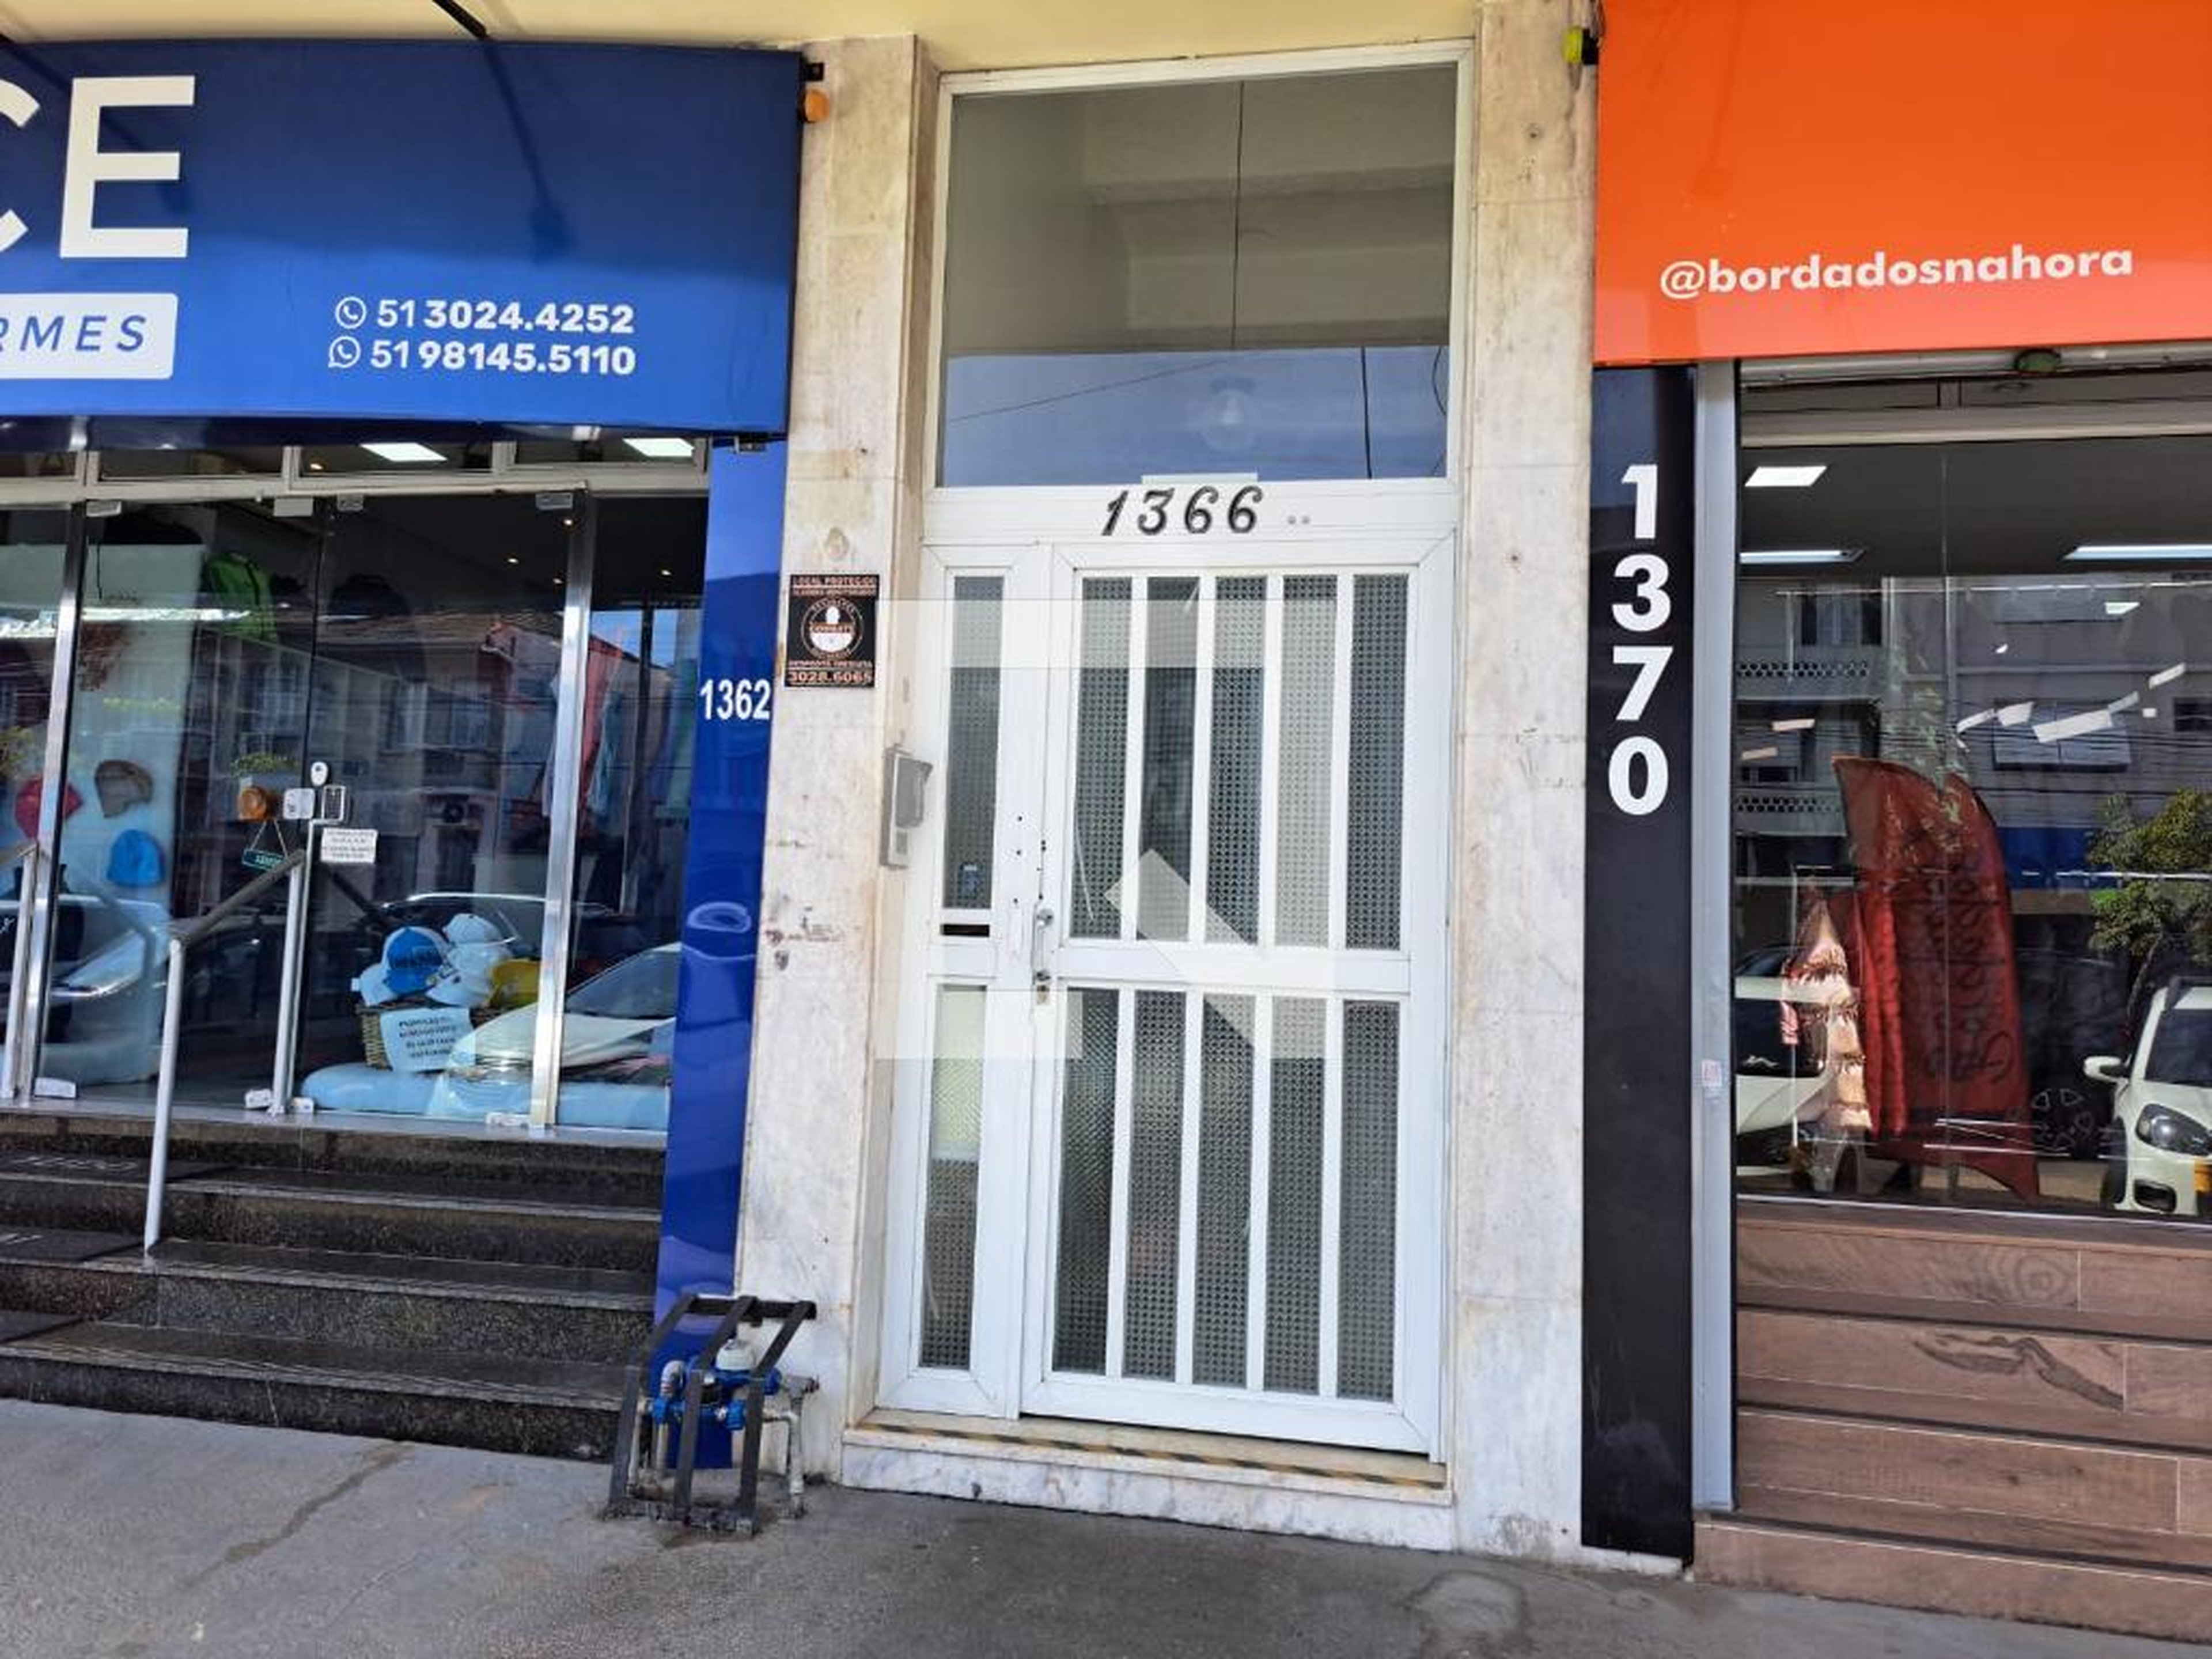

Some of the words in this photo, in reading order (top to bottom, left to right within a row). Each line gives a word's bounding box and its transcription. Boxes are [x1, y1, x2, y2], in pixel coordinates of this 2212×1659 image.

[1660, 244, 2133, 300] @bordadosnahora
[377, 300, 415, 328] 51
[424, 300, 634, 334] 3024.4252
[370, 340, 409, 369] 51
[418, 341, 635, 376] 98145.5110
[1101, 486, 1263, 536] 1366
[1608, 464, 1673, 816] 1370
[700, 679, 771, 720] 1362
